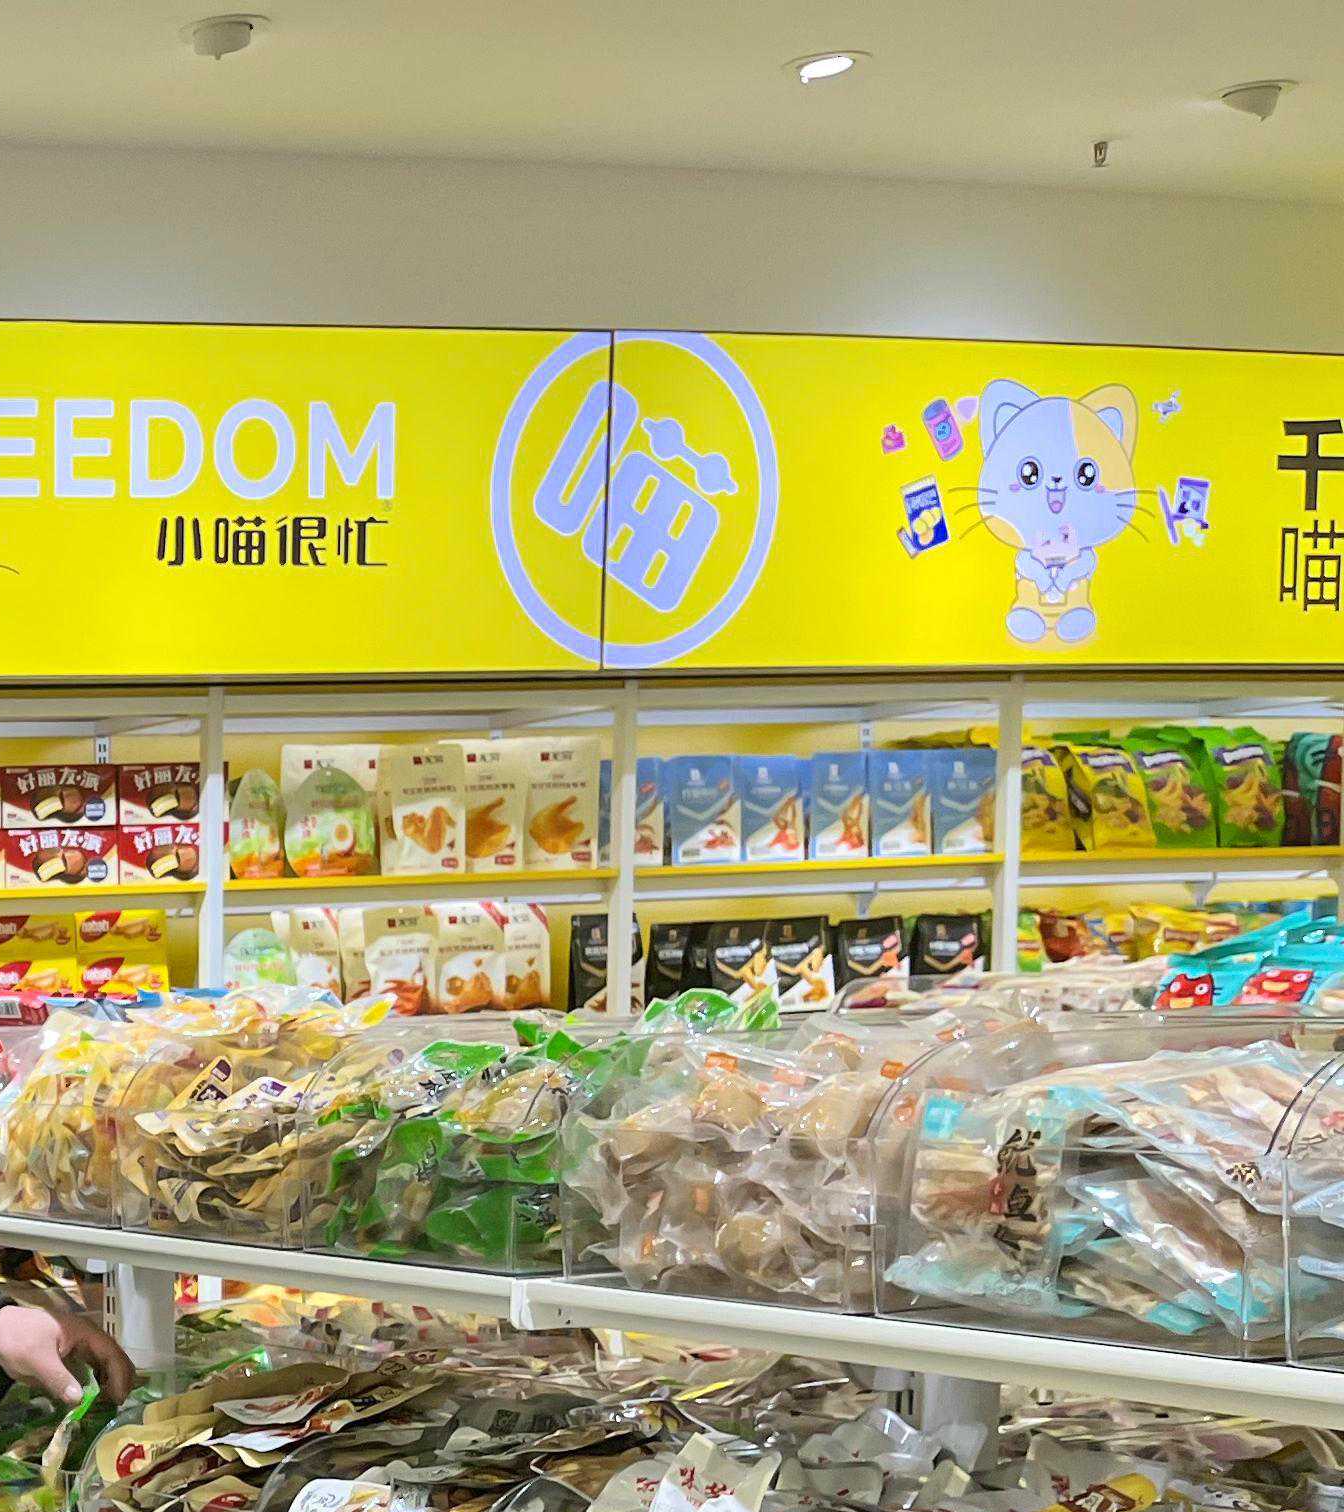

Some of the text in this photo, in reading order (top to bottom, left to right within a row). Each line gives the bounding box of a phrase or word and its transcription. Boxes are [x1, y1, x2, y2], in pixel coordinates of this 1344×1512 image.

[157, 516, 389, 567] 小喵很忙
[134, 826, 199, 854] 好丽友·
